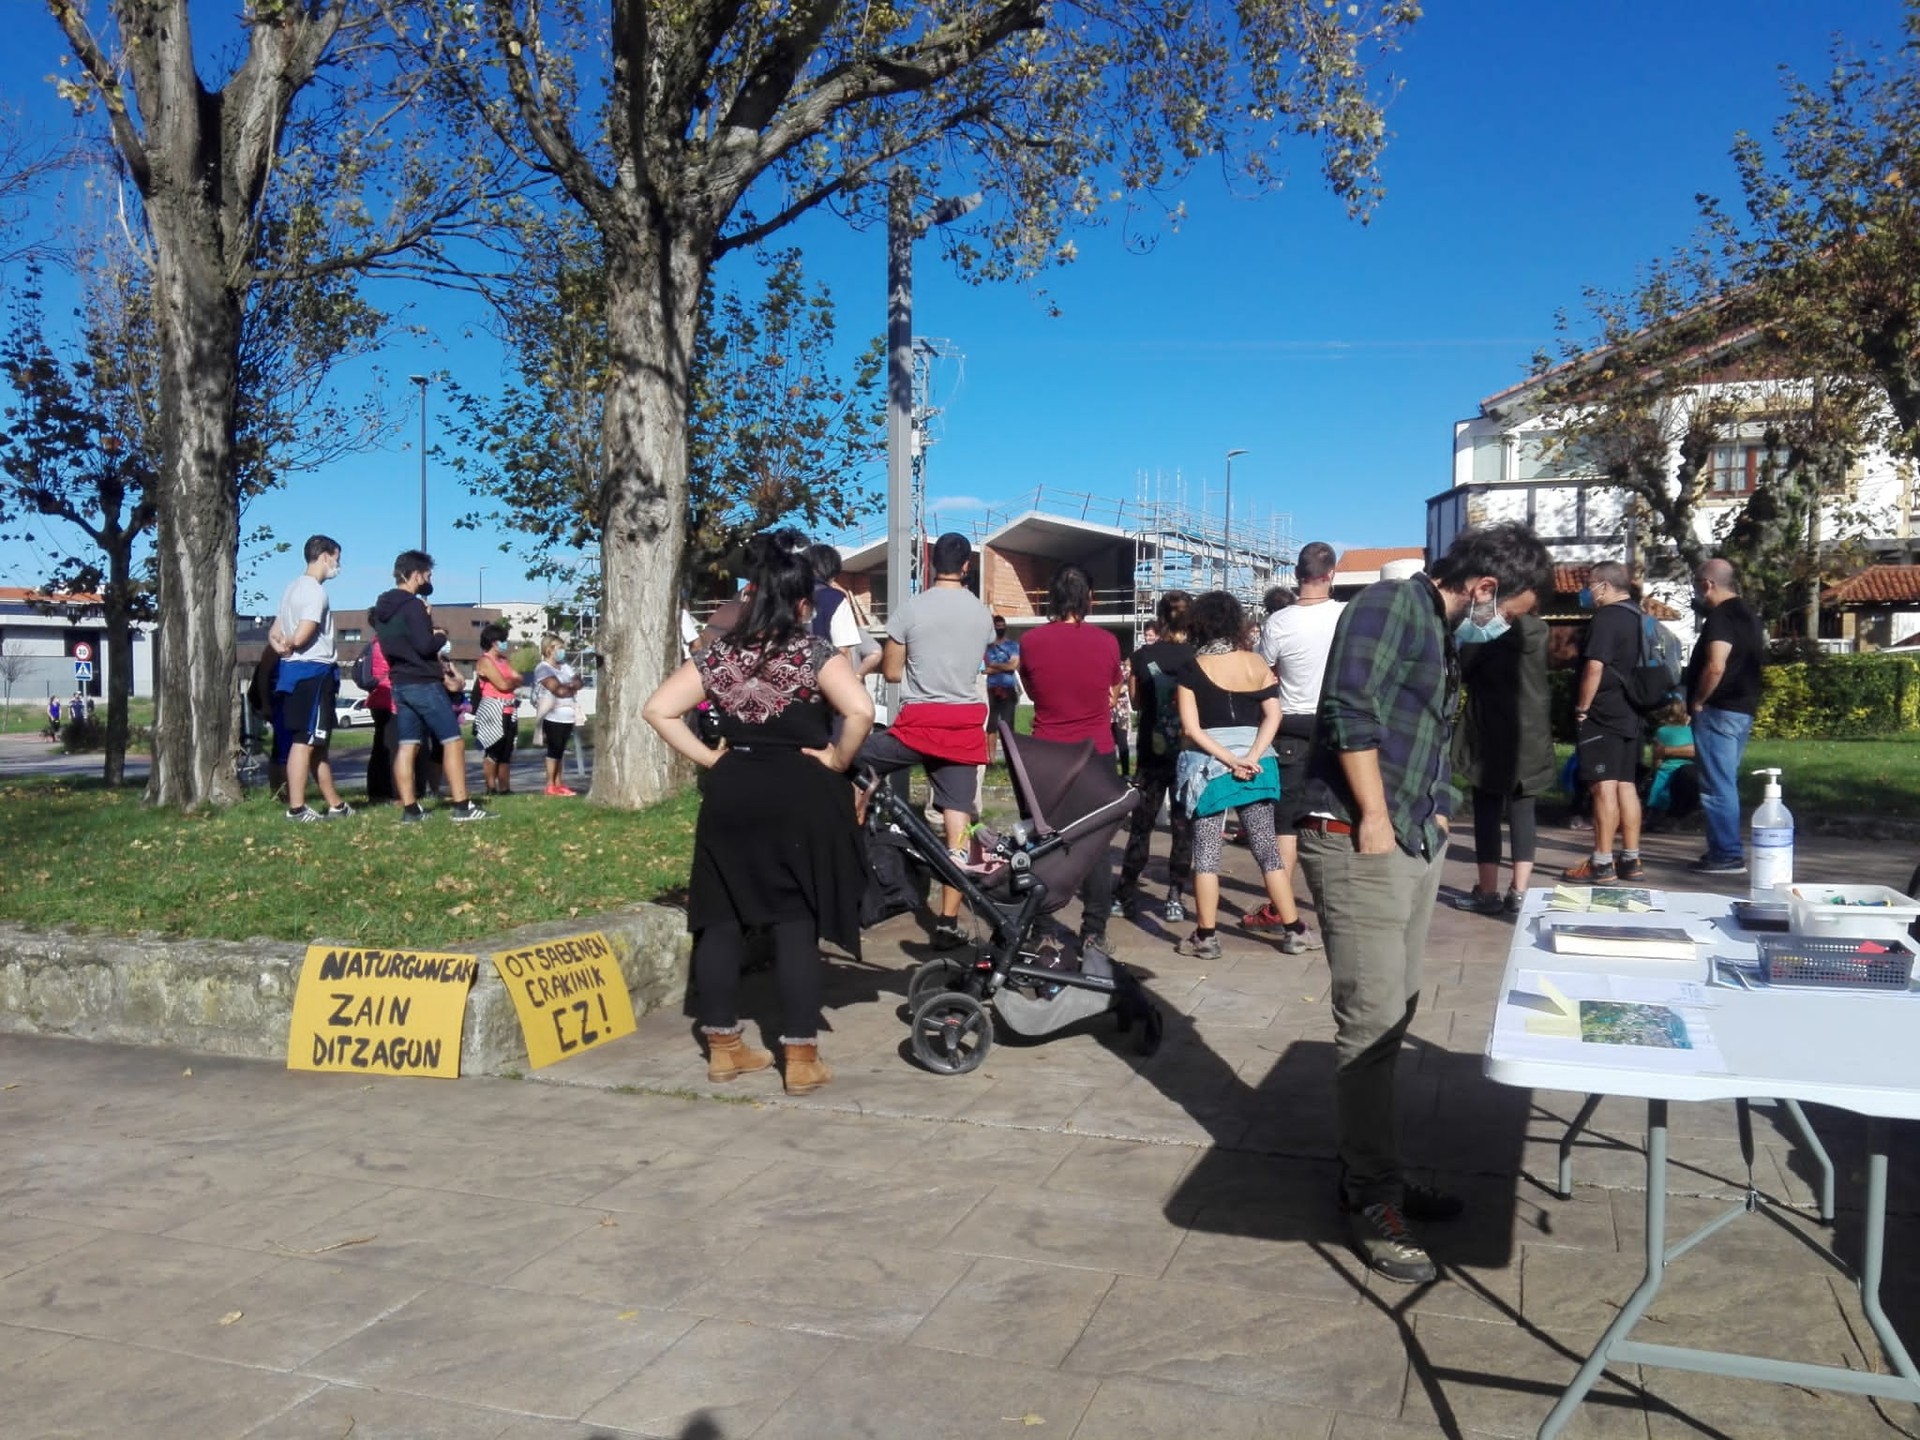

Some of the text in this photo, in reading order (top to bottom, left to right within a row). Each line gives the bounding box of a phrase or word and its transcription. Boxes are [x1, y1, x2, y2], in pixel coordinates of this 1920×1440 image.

[328, 993, 411, 1027] ZAIN
[552, 993, 611, 1052] EZ!
[313, 1033, 441, 1070] DITZAGUN
